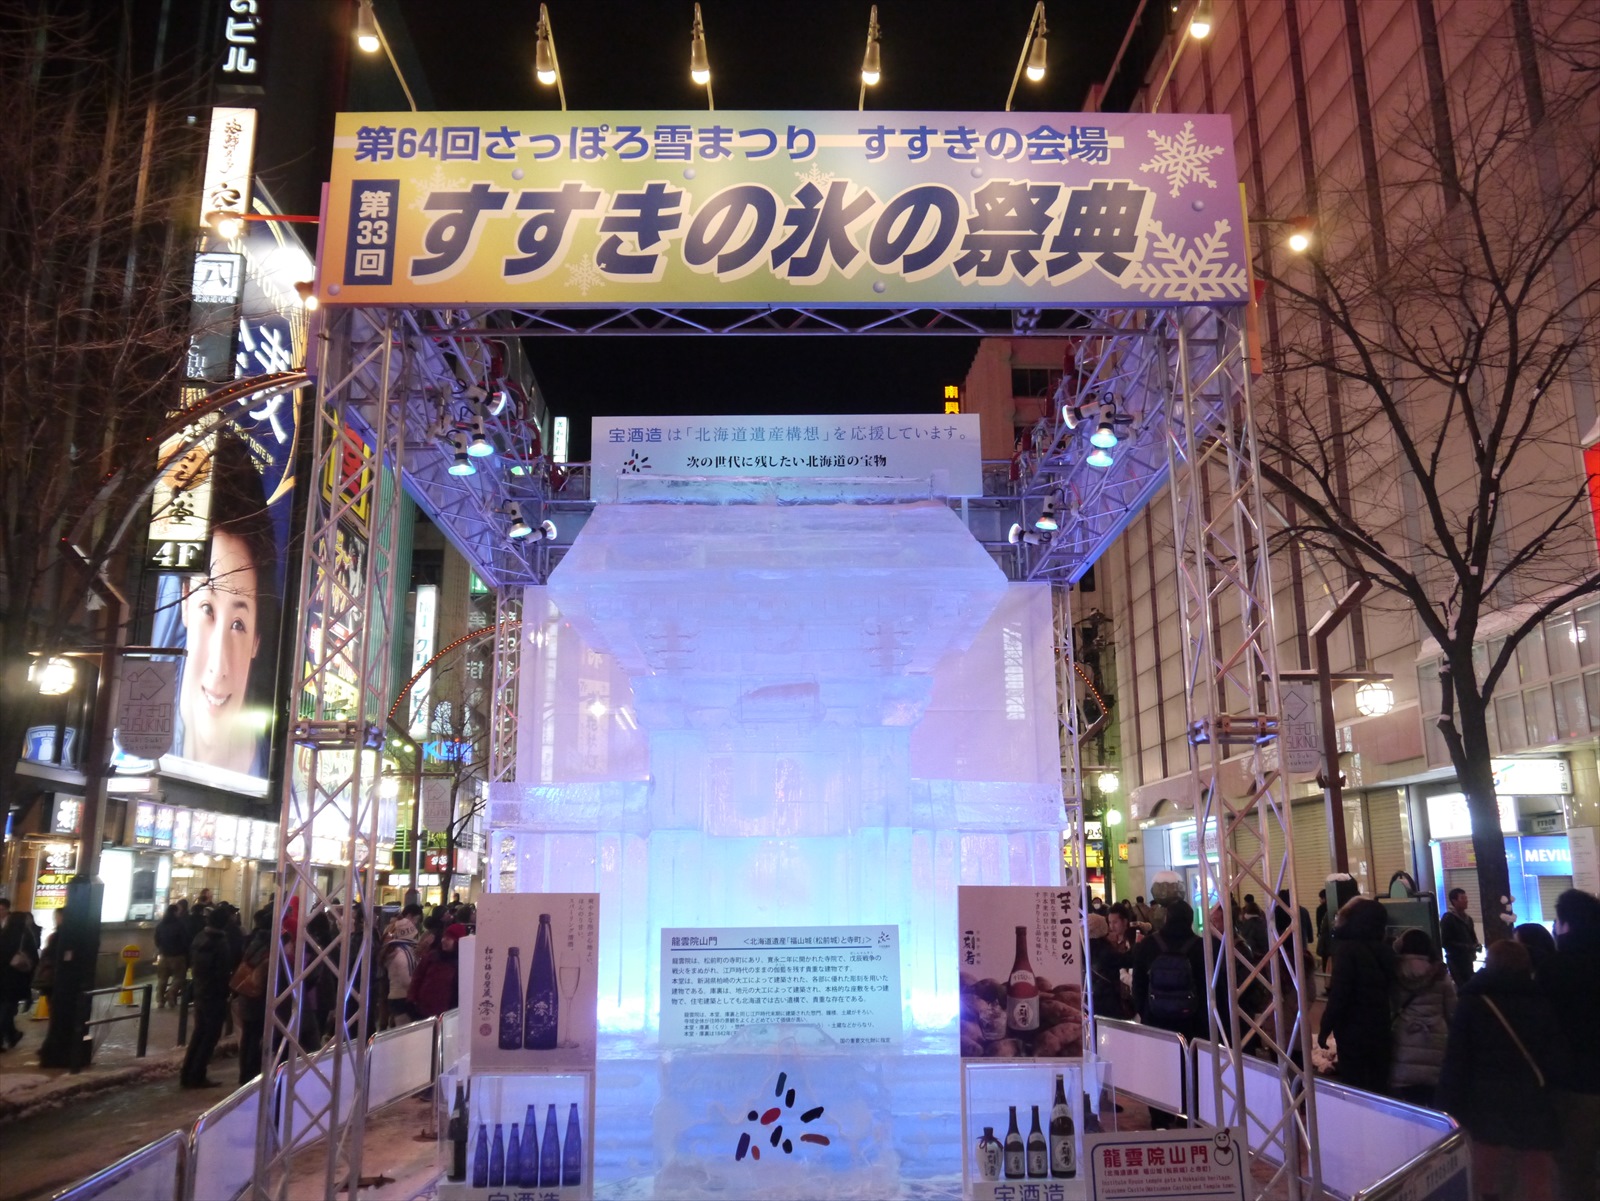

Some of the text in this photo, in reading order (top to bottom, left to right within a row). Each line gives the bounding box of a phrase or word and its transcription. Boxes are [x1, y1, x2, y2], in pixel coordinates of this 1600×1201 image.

[354, 125, 1109, 162] 第64回さっぽろ雪まつり すすきの会場
[354, 190, 391, 278] 第33回
[409, 179, 1149, 280] すすきの氷の祭典
[687, 455, 887, 468] 次の世代に残したい北海道の宝物
[152, 542, 201, 567] 4F
[1103, 1145, 1209, 1168] 龍雲院山門
